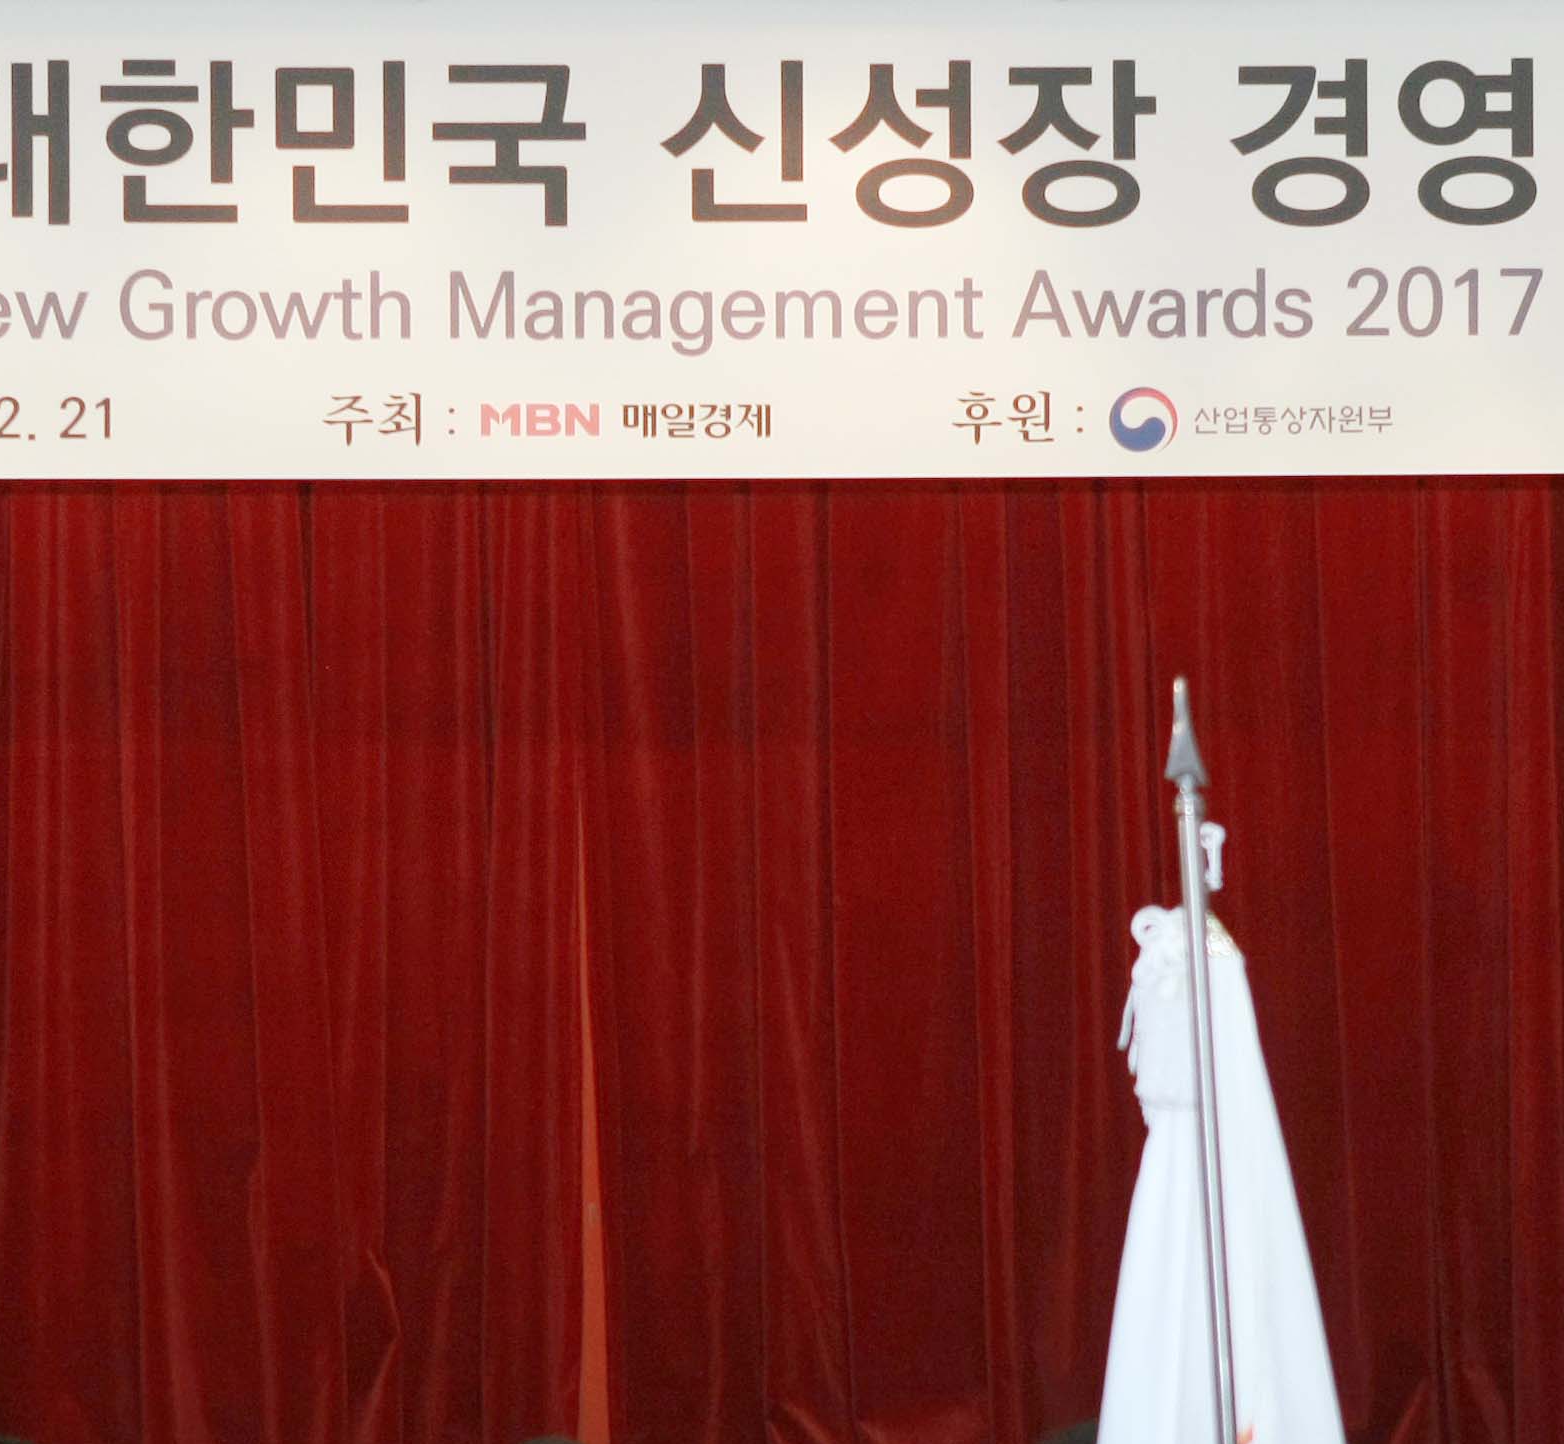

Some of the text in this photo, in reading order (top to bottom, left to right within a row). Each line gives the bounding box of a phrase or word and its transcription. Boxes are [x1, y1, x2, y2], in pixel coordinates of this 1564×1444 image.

[660, 60, 1157, 229] 신성장
[120, 269, 411, 341] Growth
[450, 271, 983, 357] Management
[1012, 268, 1314, 340] Awards
[1346, 266, 1544, 339] 2017
[59, 396, 112, 441] 21
[481, 403, 600, 437] MBN
[621, 403, 772, 440] 매일경제
[1194, 405, 1394, 436] 산업통상자원부
